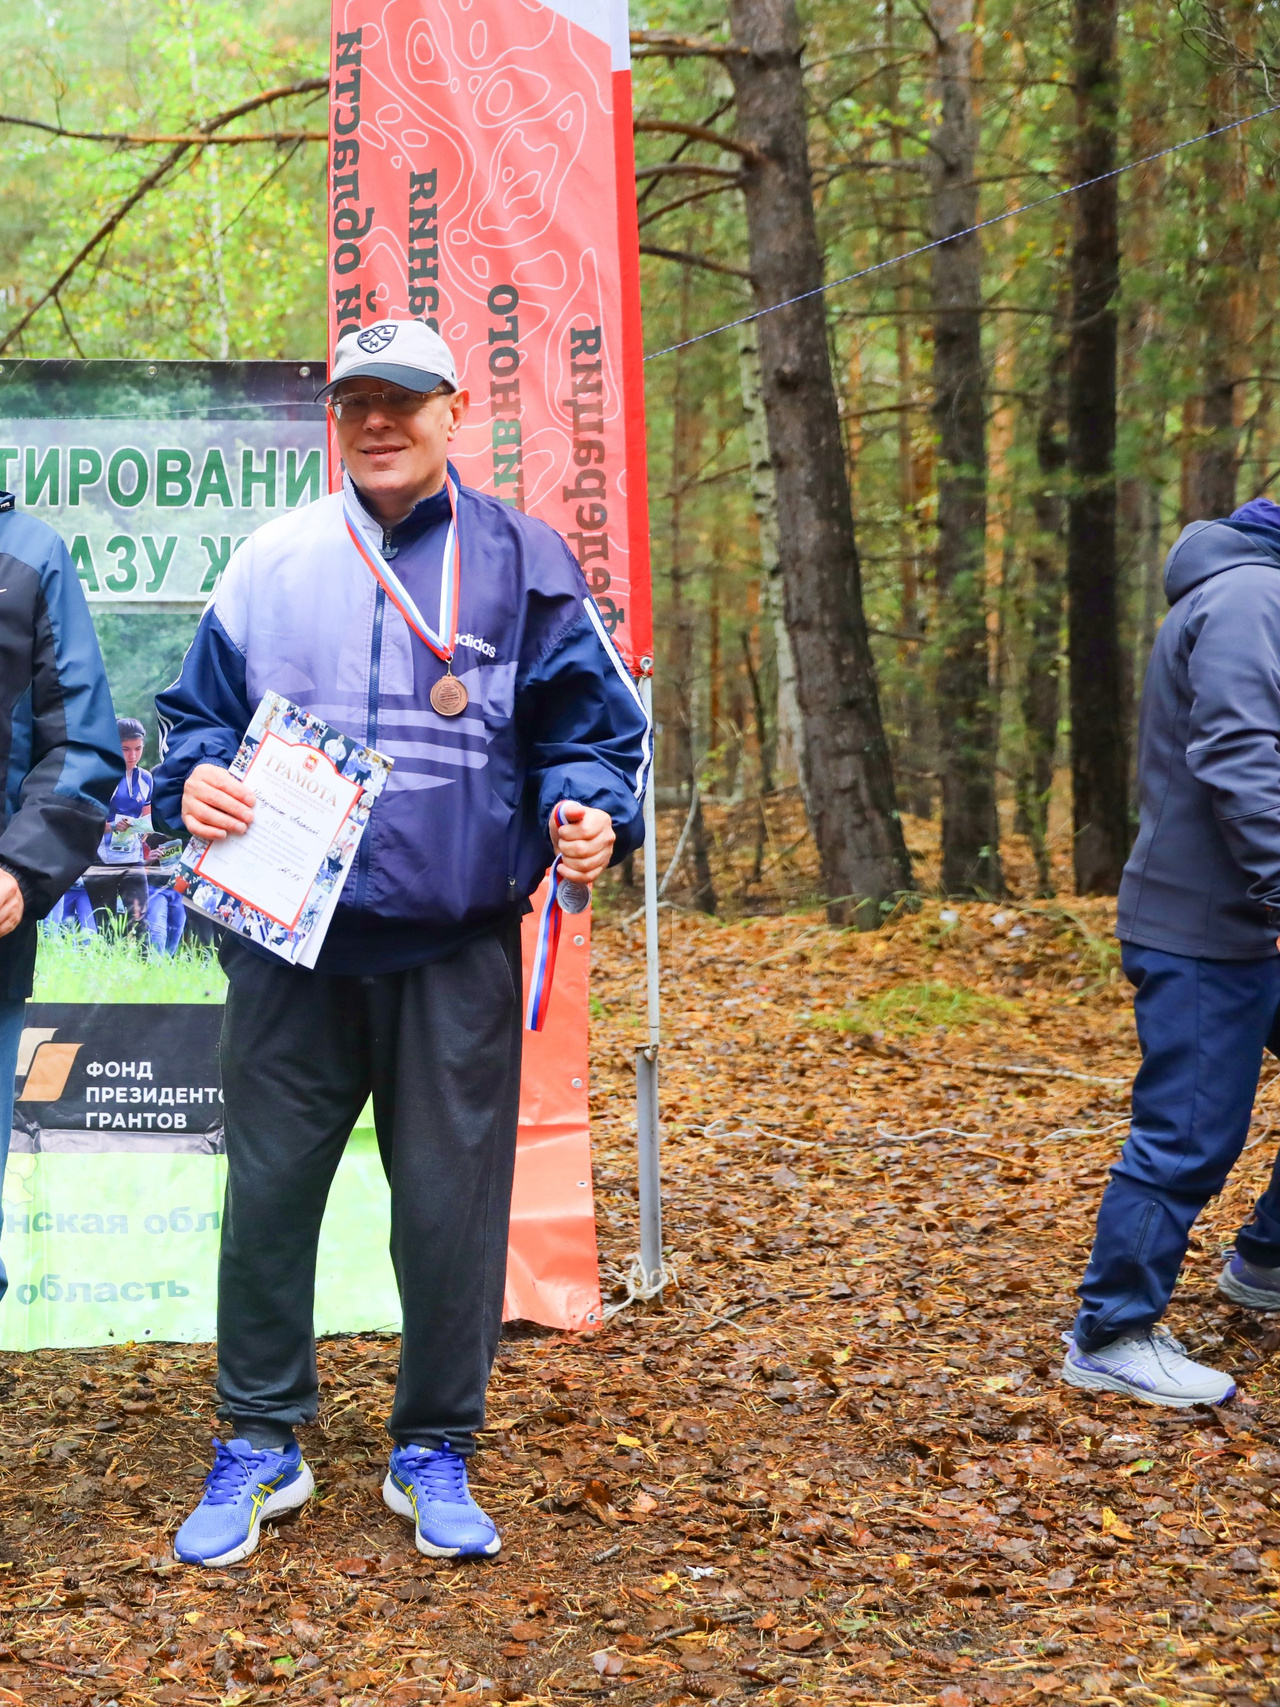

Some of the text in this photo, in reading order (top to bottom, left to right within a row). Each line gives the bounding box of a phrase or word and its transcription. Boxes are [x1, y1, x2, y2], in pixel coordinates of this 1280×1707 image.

[68, 534, 178, 593] АЗУ
[266, 753, 337, 807] ГРАМОТА
[86, 1061, 153, 1080] ФОНД
[86, 1112, 187, 1129] ГРАНТОВ
[16, 1273, 190, 1306] область
